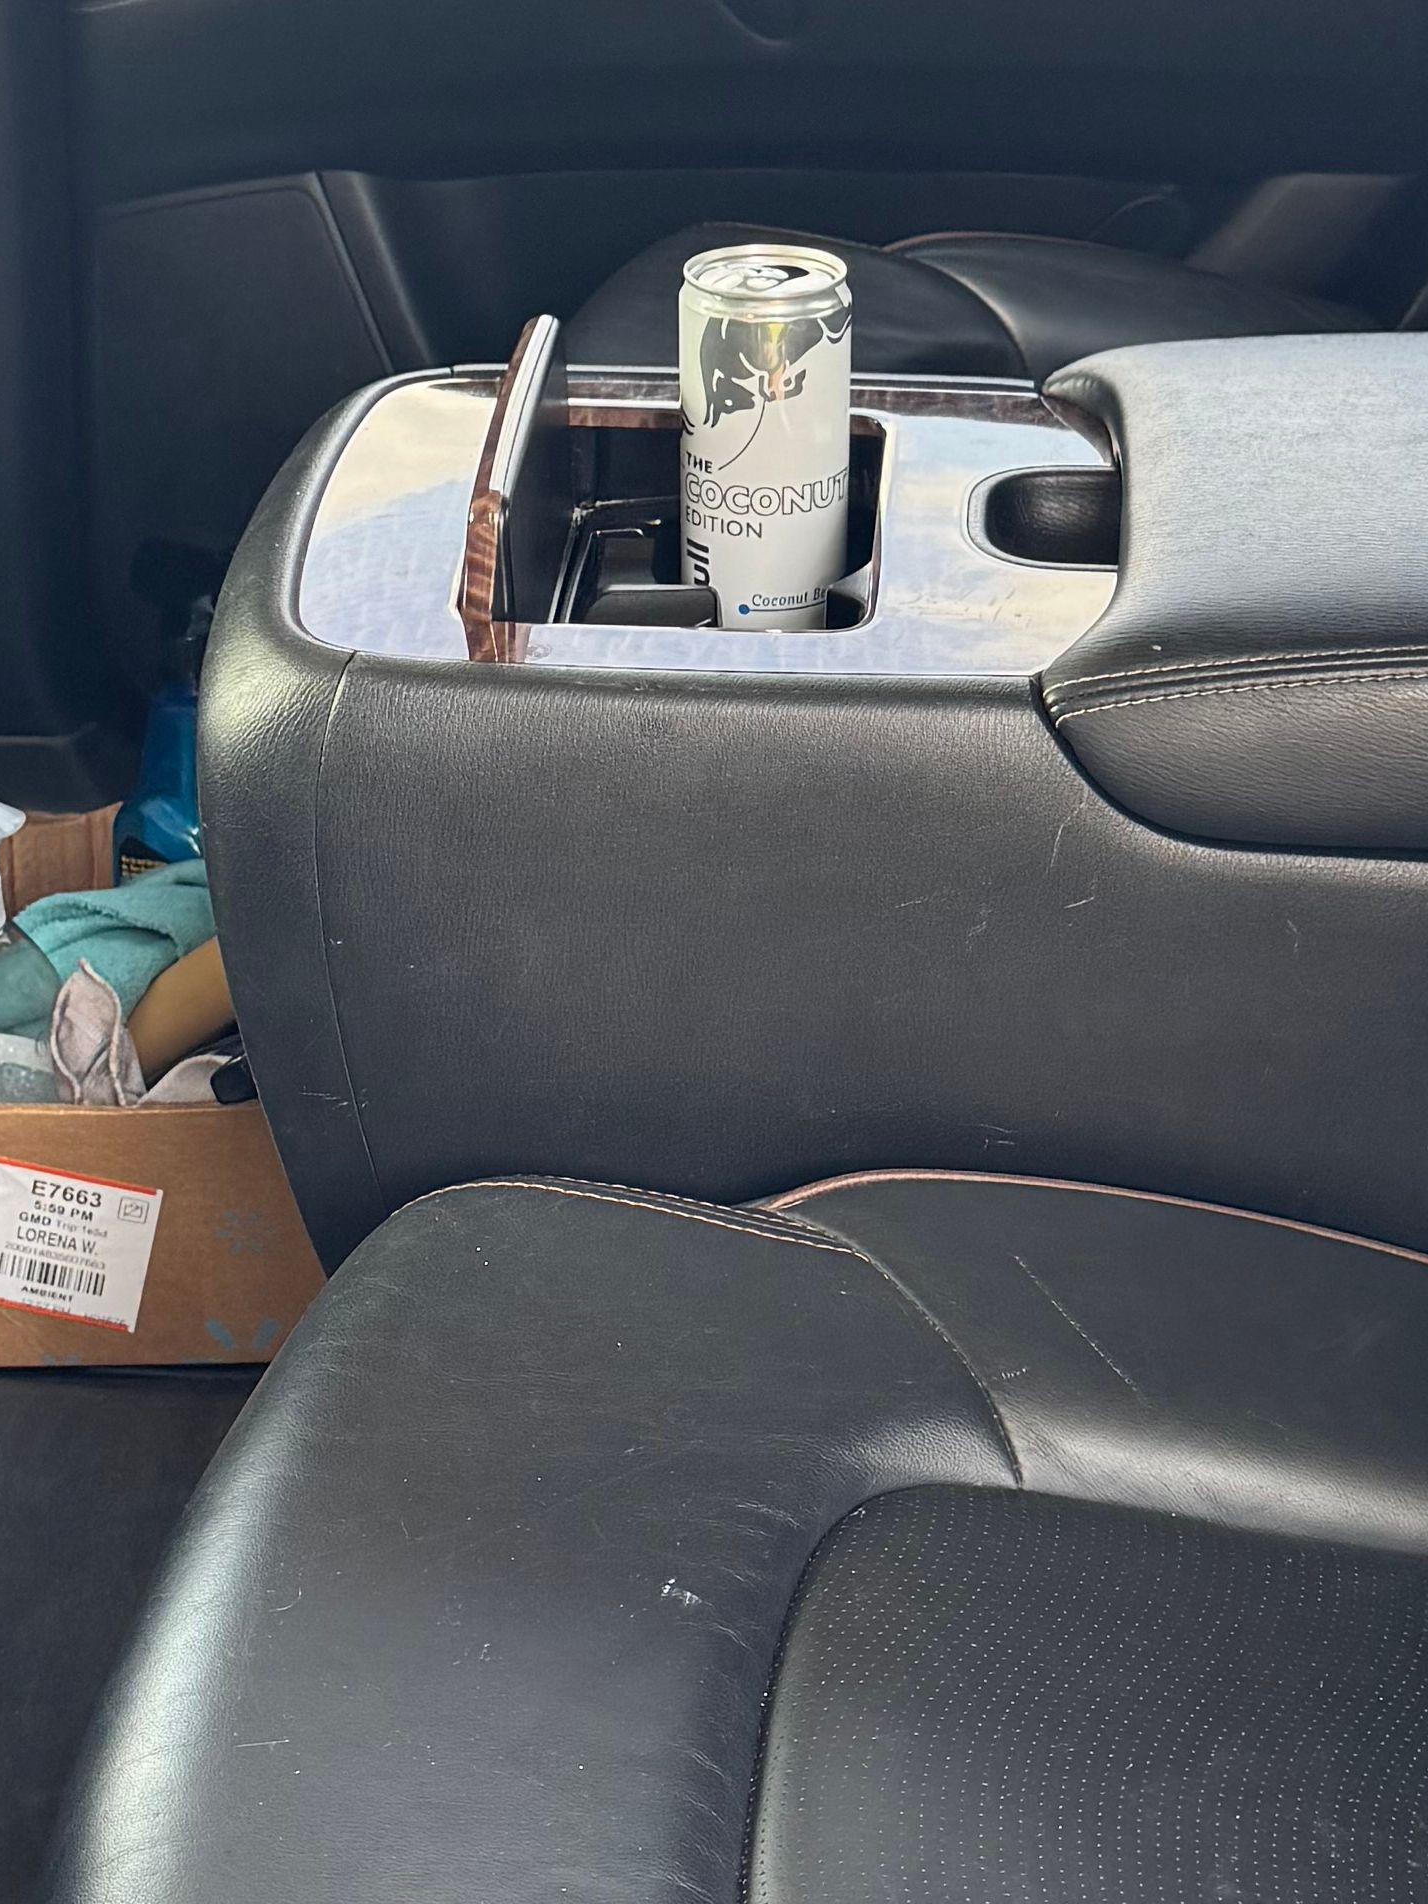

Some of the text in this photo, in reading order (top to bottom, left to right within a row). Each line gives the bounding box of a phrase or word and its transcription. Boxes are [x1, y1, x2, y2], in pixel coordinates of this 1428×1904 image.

[685, 450, 713, 474] THE
[685, 466, 848, 517] COCONUT
[685, 505, 763, 539] EDITION
[686, 538, 710, 587] ull
[751, 591, 808, 607] Coconut
[31, 1179, 102, 1208] E7663
[18, 1211, 52, 1226] GMD
[34, 1200, 93, 1222] 5:59 PM
[17, 1226, 77, 1252] LORENA
[82, 1239, 98, 1256] W.
[21, 1285, 74, 1303] AMBIENT
